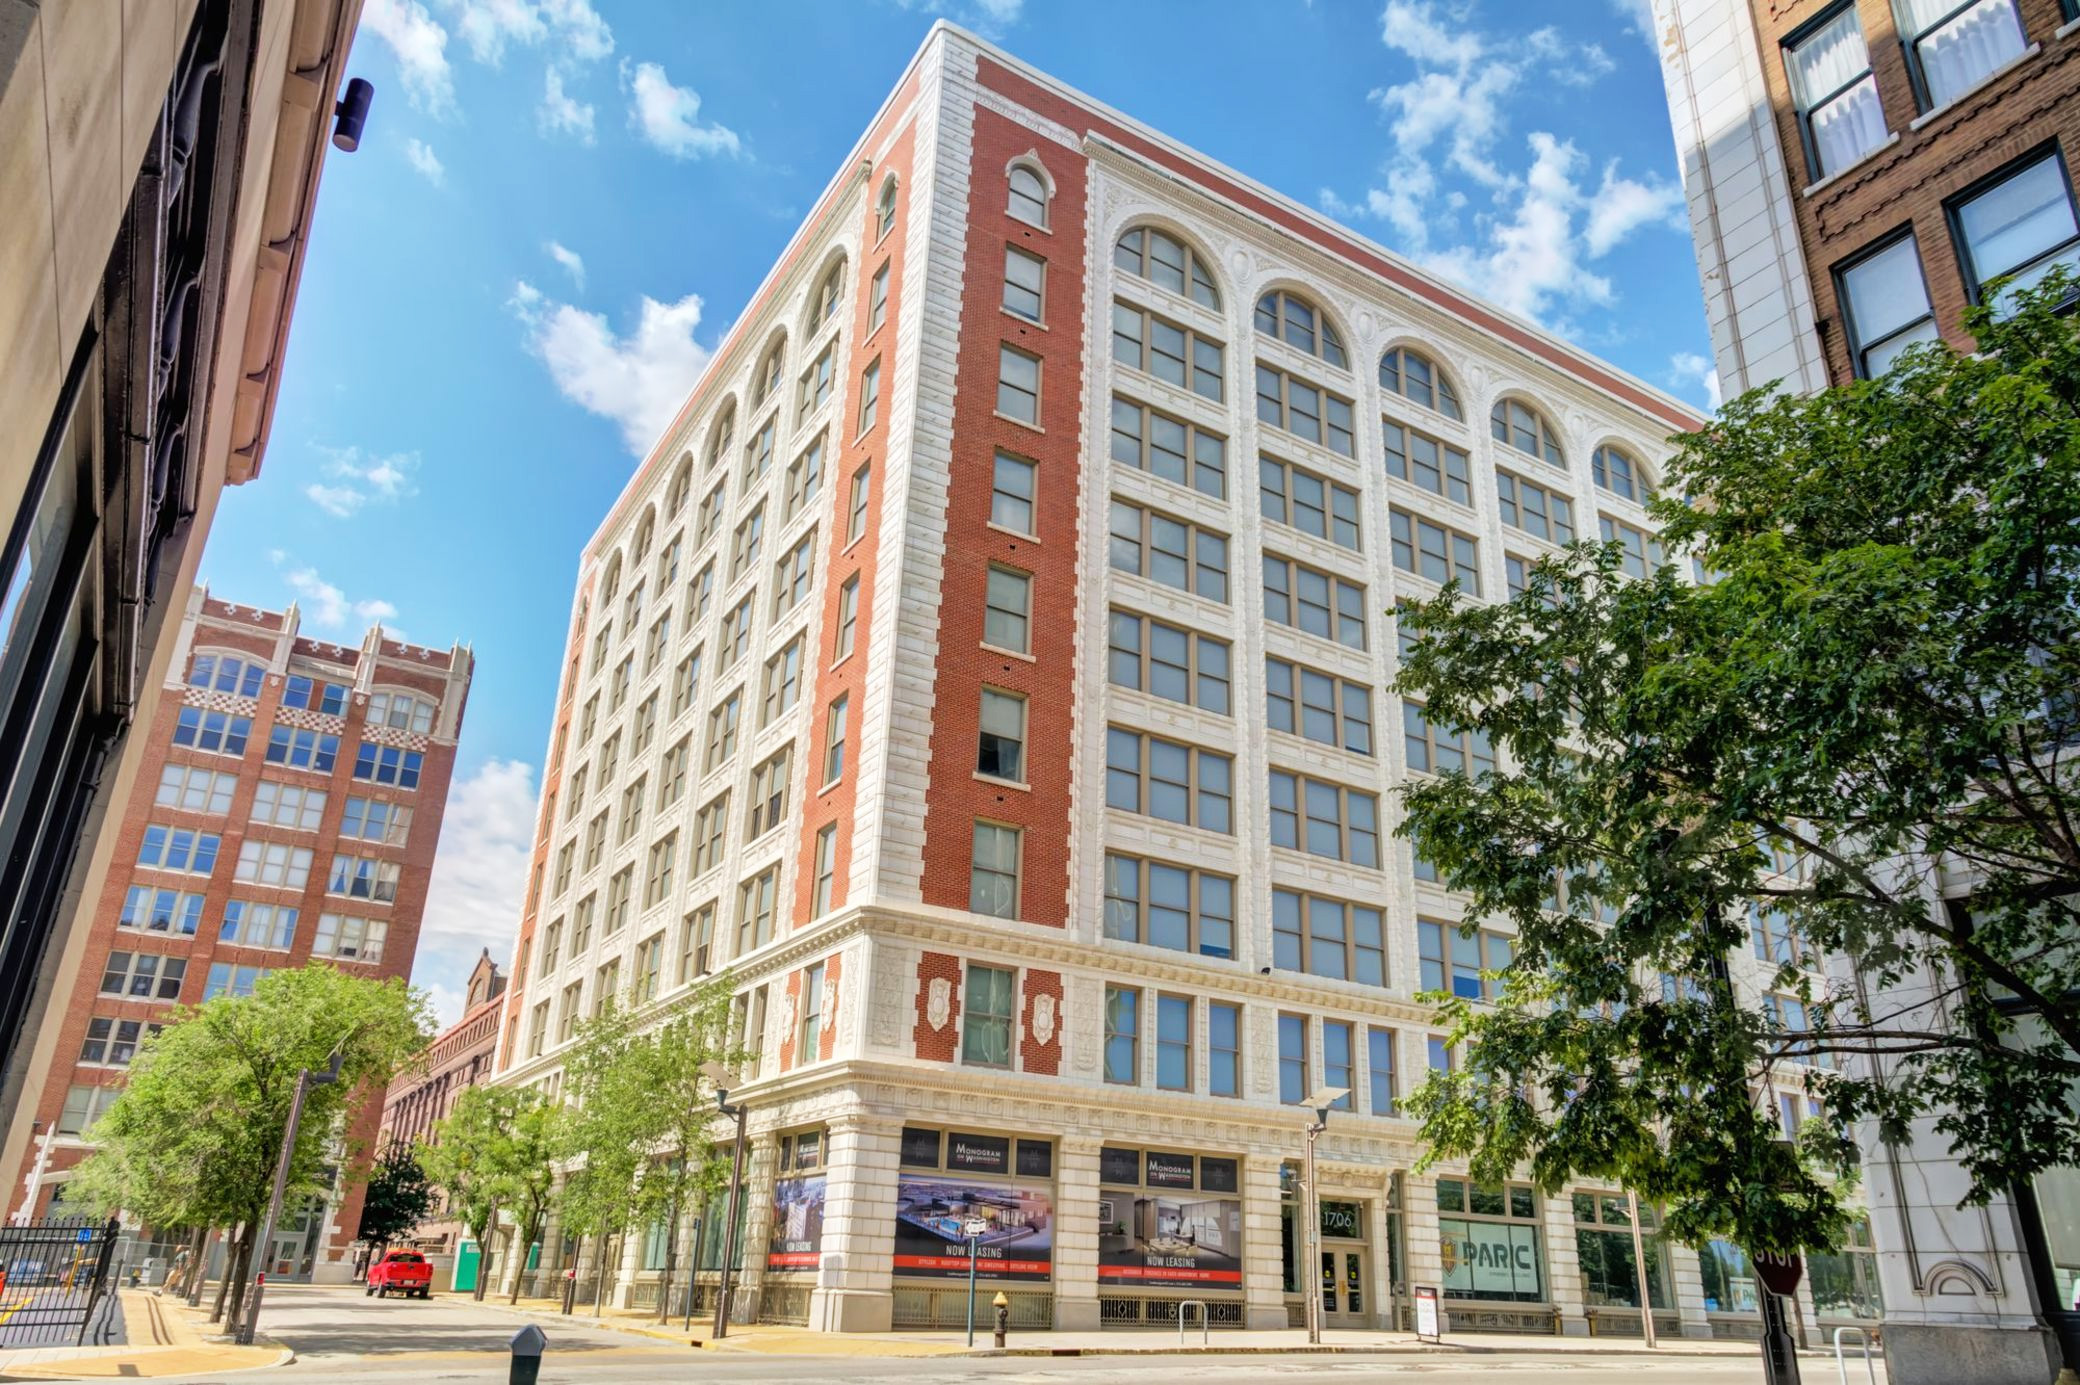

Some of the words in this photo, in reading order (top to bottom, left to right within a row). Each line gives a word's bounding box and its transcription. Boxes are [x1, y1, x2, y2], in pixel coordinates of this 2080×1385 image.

[956, 1143, 1001, 1157] MONOGRAM
[1149, 1159, 1192, 1174] MONOGRAM
[1324, 1211, 1352, 1227] 1706
[946, 1245, 965, 1256] NOW
[968, 1246, 1002, 1258] LASING
[1147, 1256, 1164, 1266] NOW
[1166, 1257, 1196, 1269] LEASING
